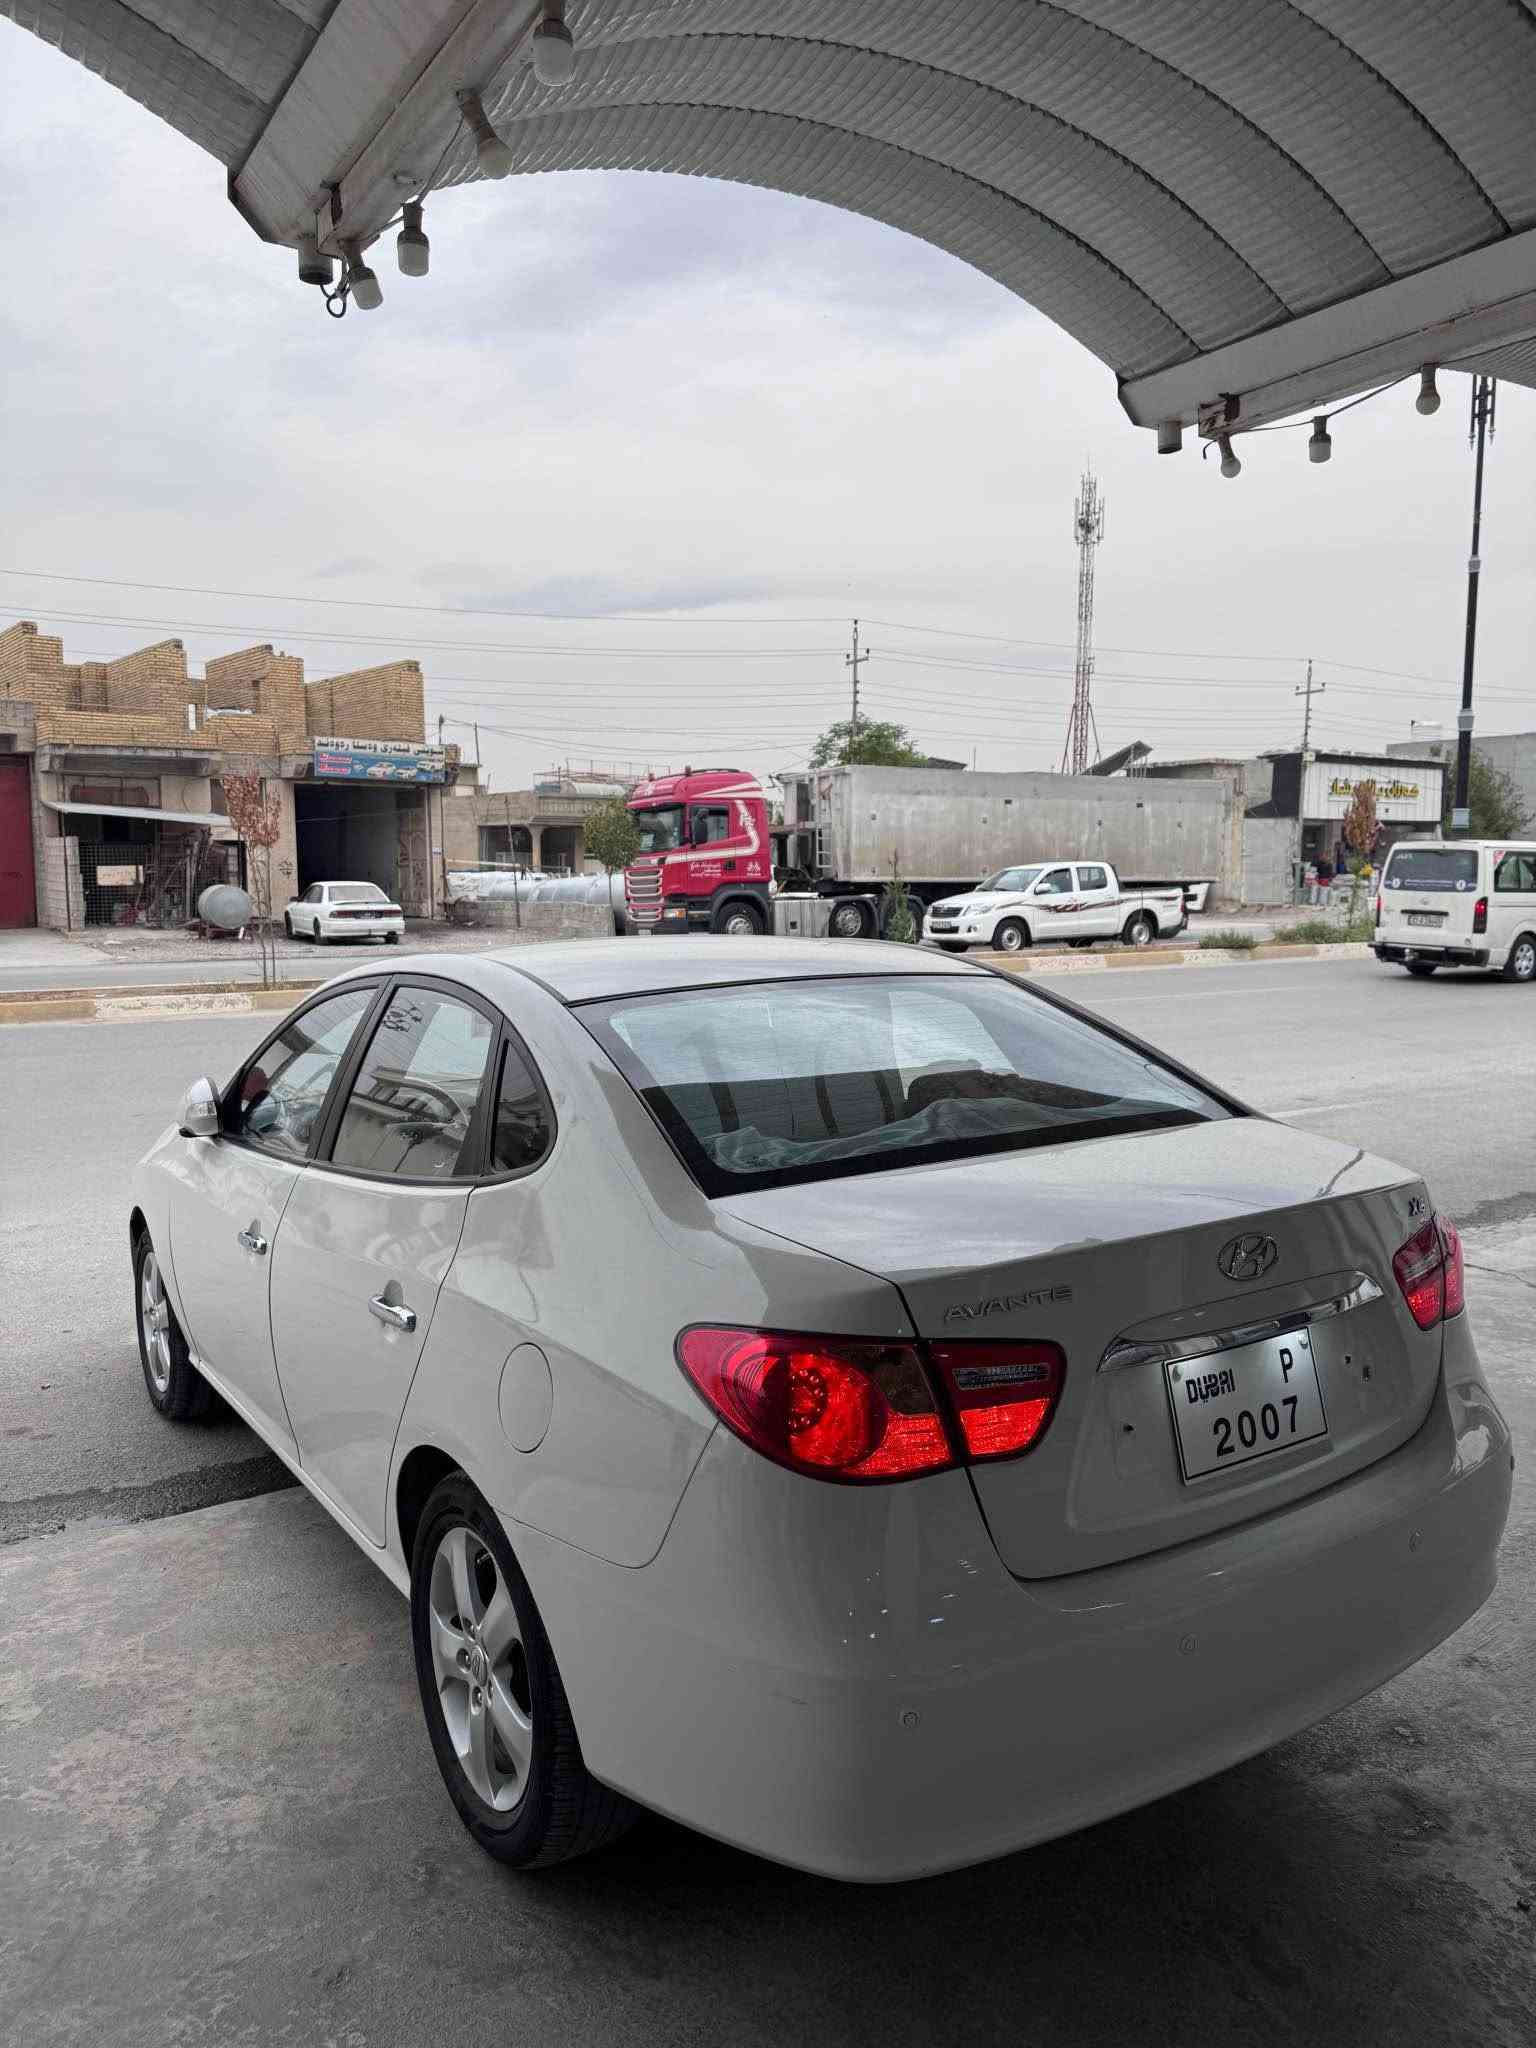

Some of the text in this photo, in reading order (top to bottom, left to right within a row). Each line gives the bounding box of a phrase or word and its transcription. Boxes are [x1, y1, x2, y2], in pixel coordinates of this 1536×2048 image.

[943, 1285, 1072, 1323] AVANTE
[1185, 1348, 1293, 1404] DUBAI P
[1213, 1395, 1299, 1457] 2007
